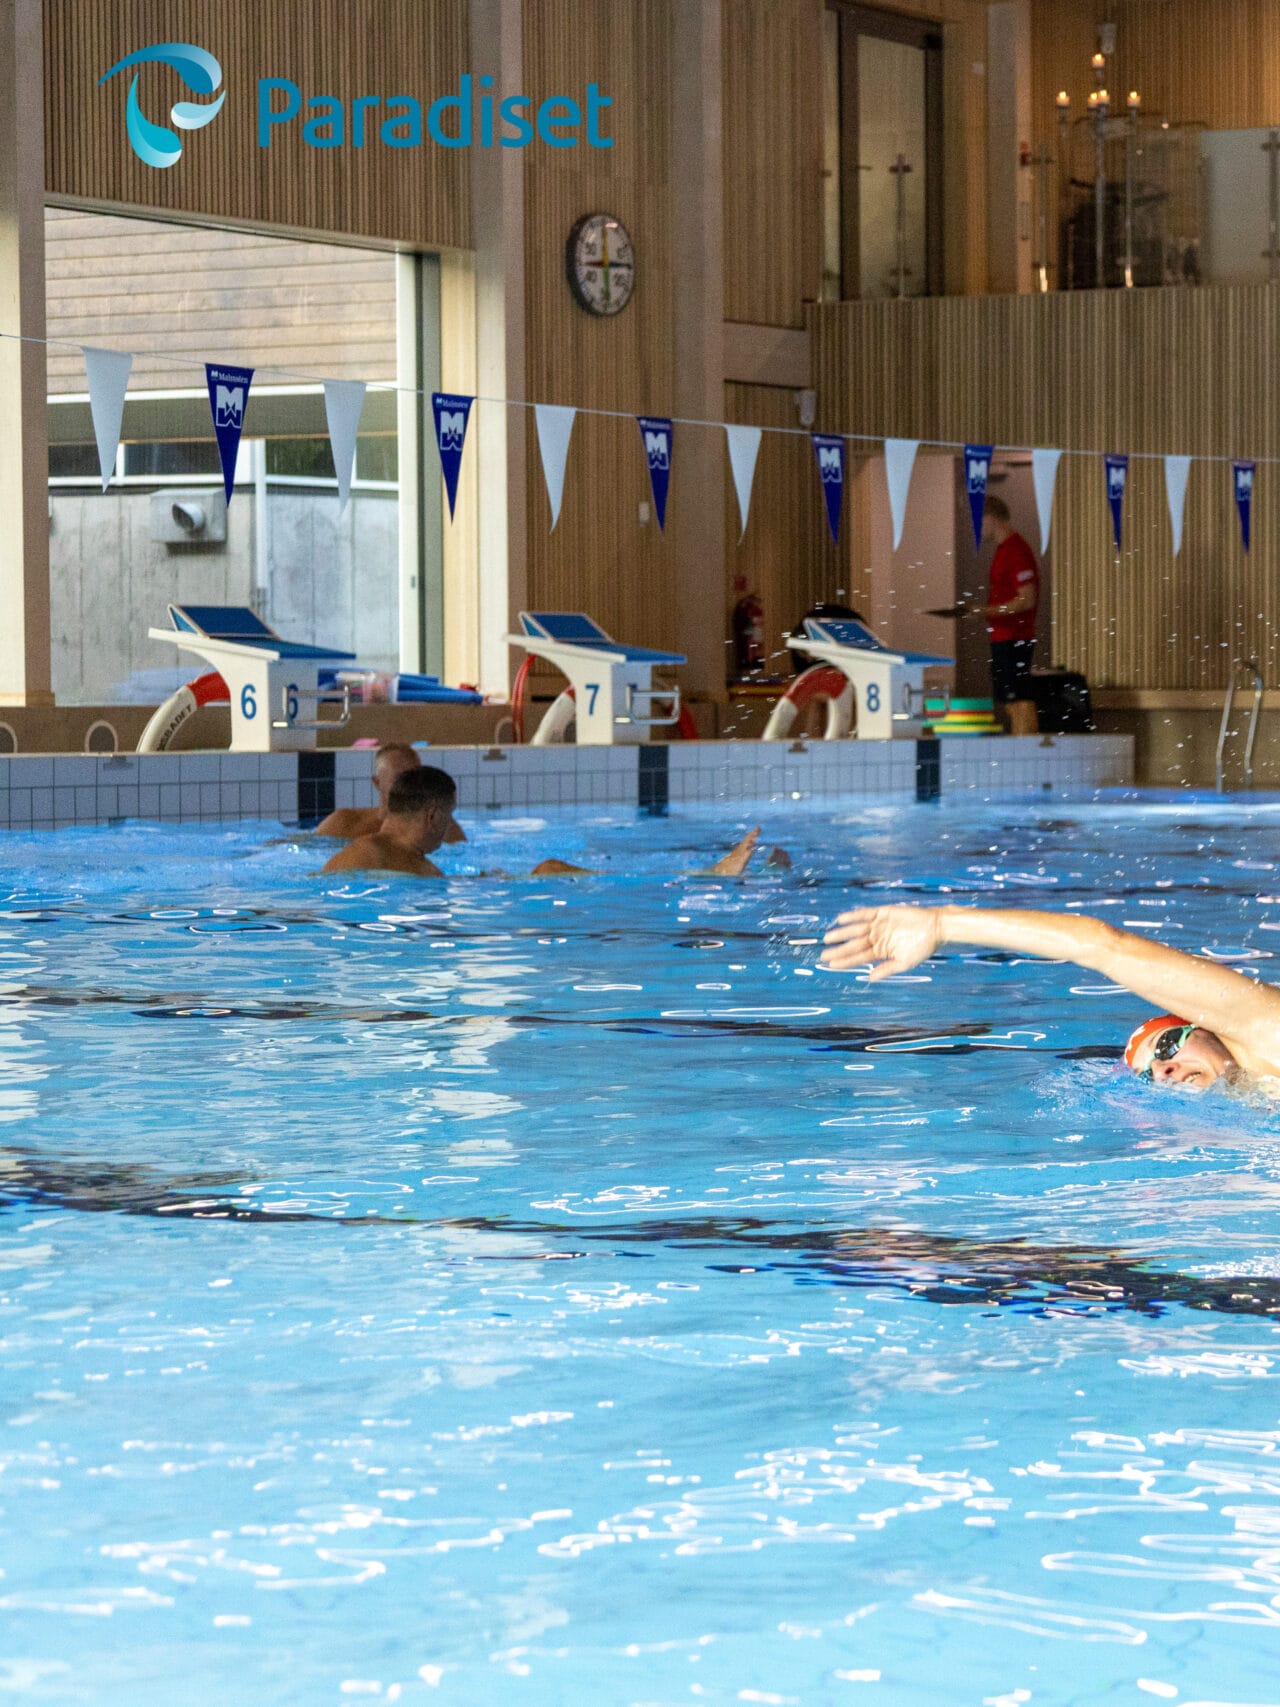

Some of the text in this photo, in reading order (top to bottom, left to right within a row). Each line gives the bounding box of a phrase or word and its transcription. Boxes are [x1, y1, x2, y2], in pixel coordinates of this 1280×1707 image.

[241, 683, 258, 720] 6
[585, 684, 600, 716] 7
[866, 683, 881, 713] 8
